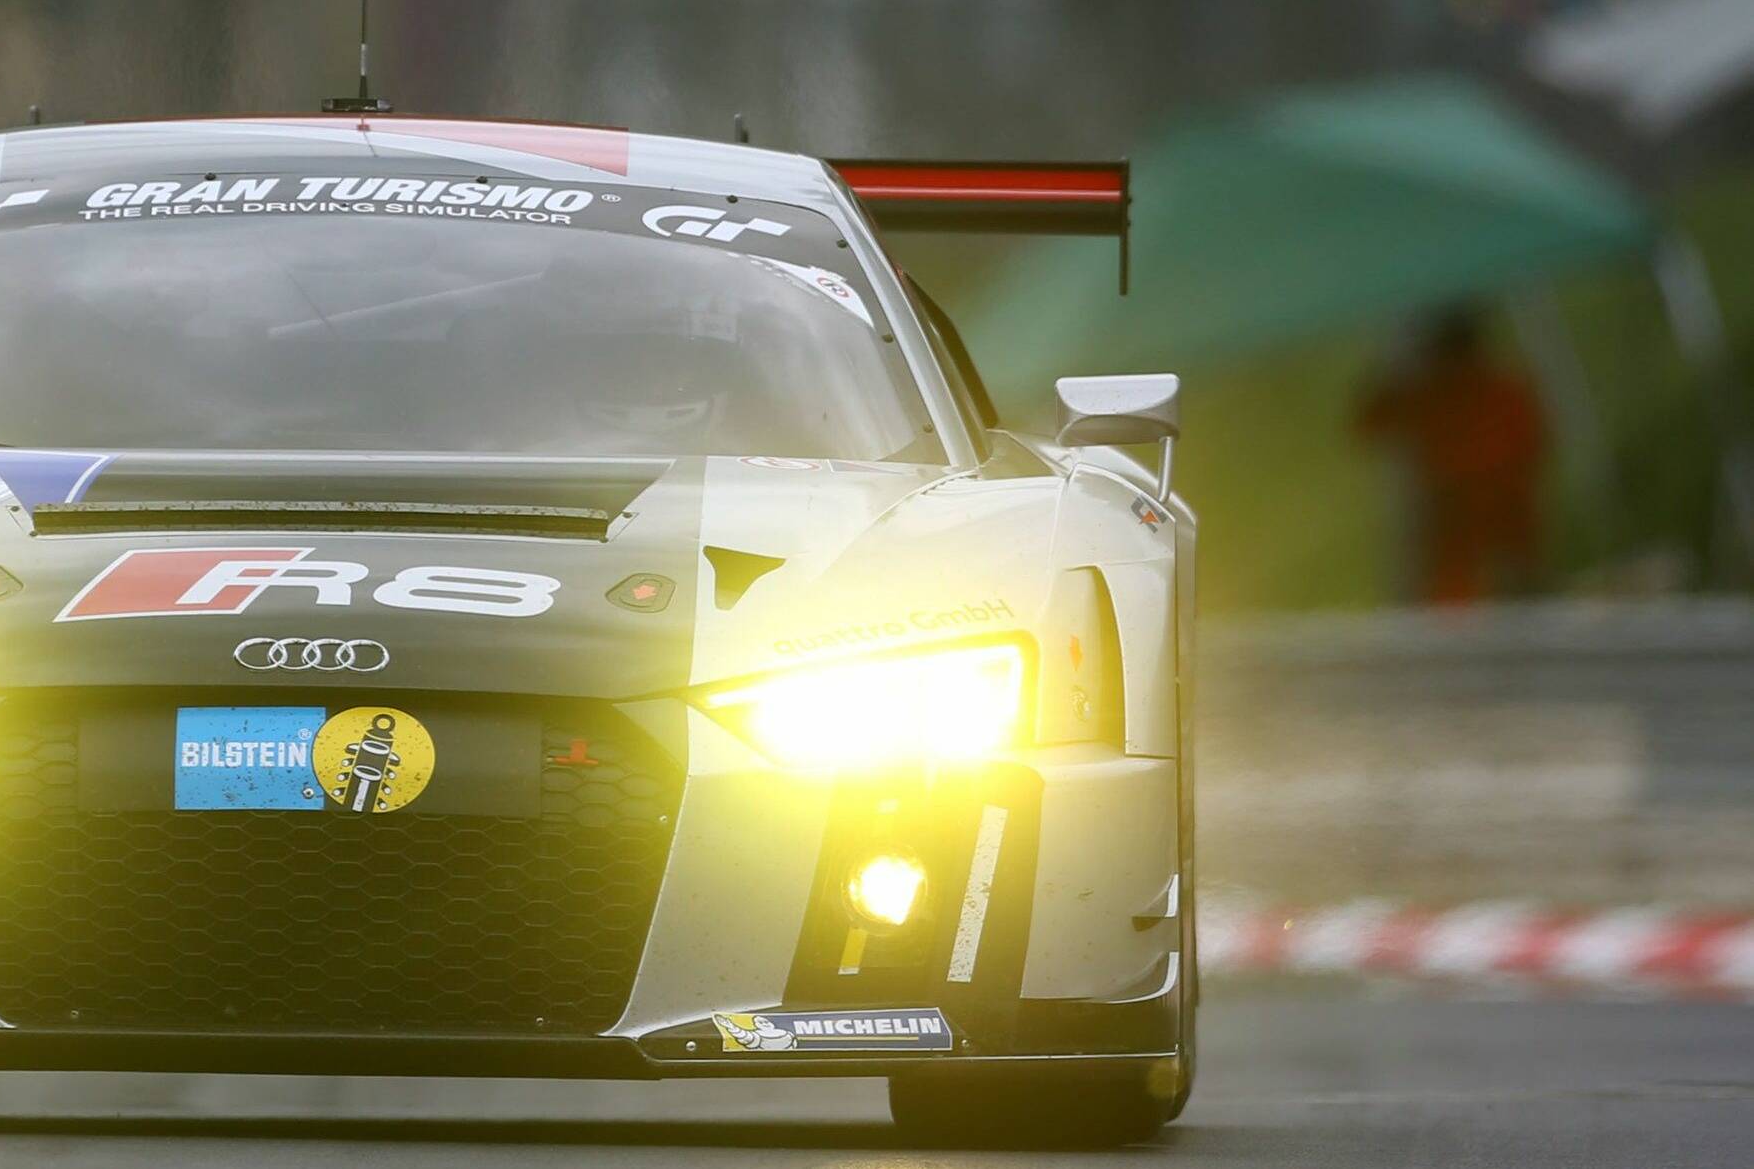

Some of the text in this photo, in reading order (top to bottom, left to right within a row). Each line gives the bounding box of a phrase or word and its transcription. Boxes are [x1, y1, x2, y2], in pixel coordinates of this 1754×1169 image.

[86, 177, 594, 212] GRAN TURISMO
[78, 201, 572, 225] THE REAL DRIVING SIMULATOR
[176, 560, 561, 617] R8
[910, 598, 1015, 631] GmbH
[181, 740, 308, 768] BILSTEIN
[794, 1017, 941, 1036] MICHELIN
